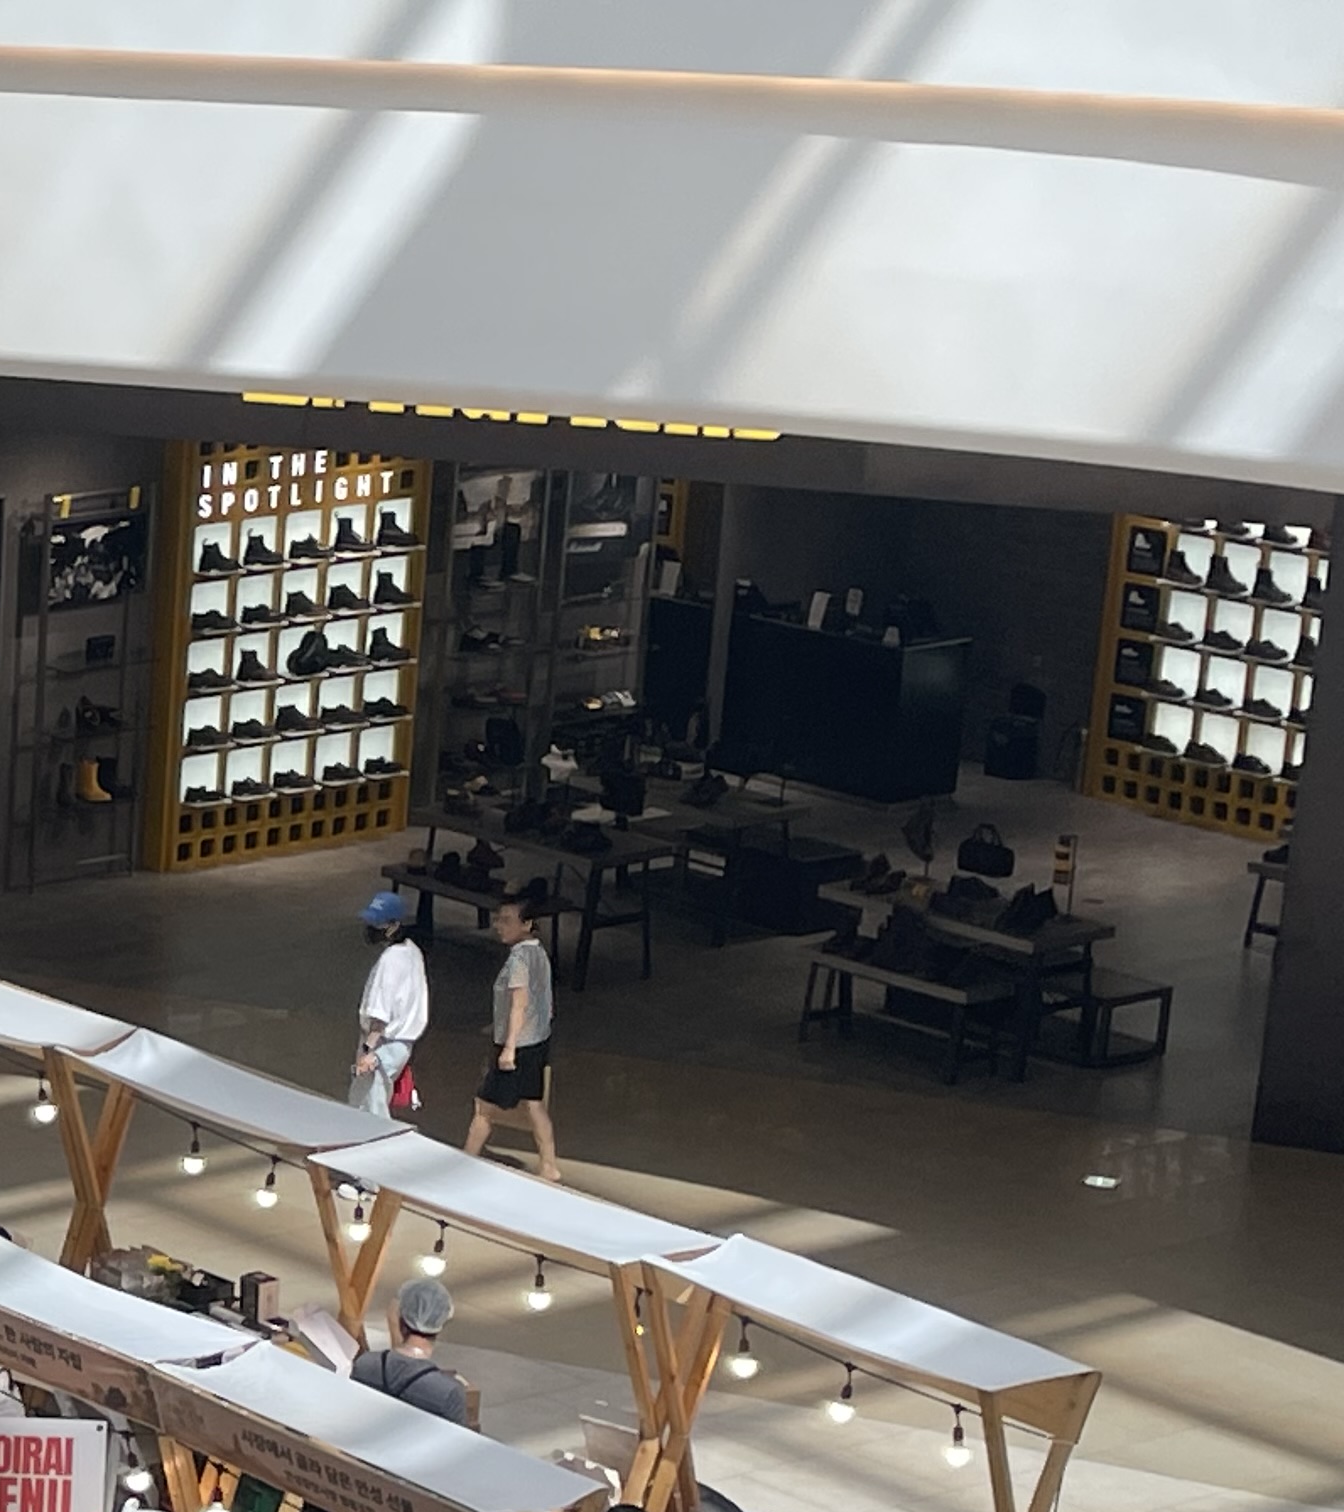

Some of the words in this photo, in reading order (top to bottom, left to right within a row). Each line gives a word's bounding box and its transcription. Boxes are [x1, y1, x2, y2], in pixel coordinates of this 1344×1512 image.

[202, 462, 238, 489] IN
[269, 450, 328, 480] THE
[198, 470, 394, 518] SPOTLIGHT
[241, 1429, 293, 1466] 시장에서
[355, 1478, 384, 1505] 안성
